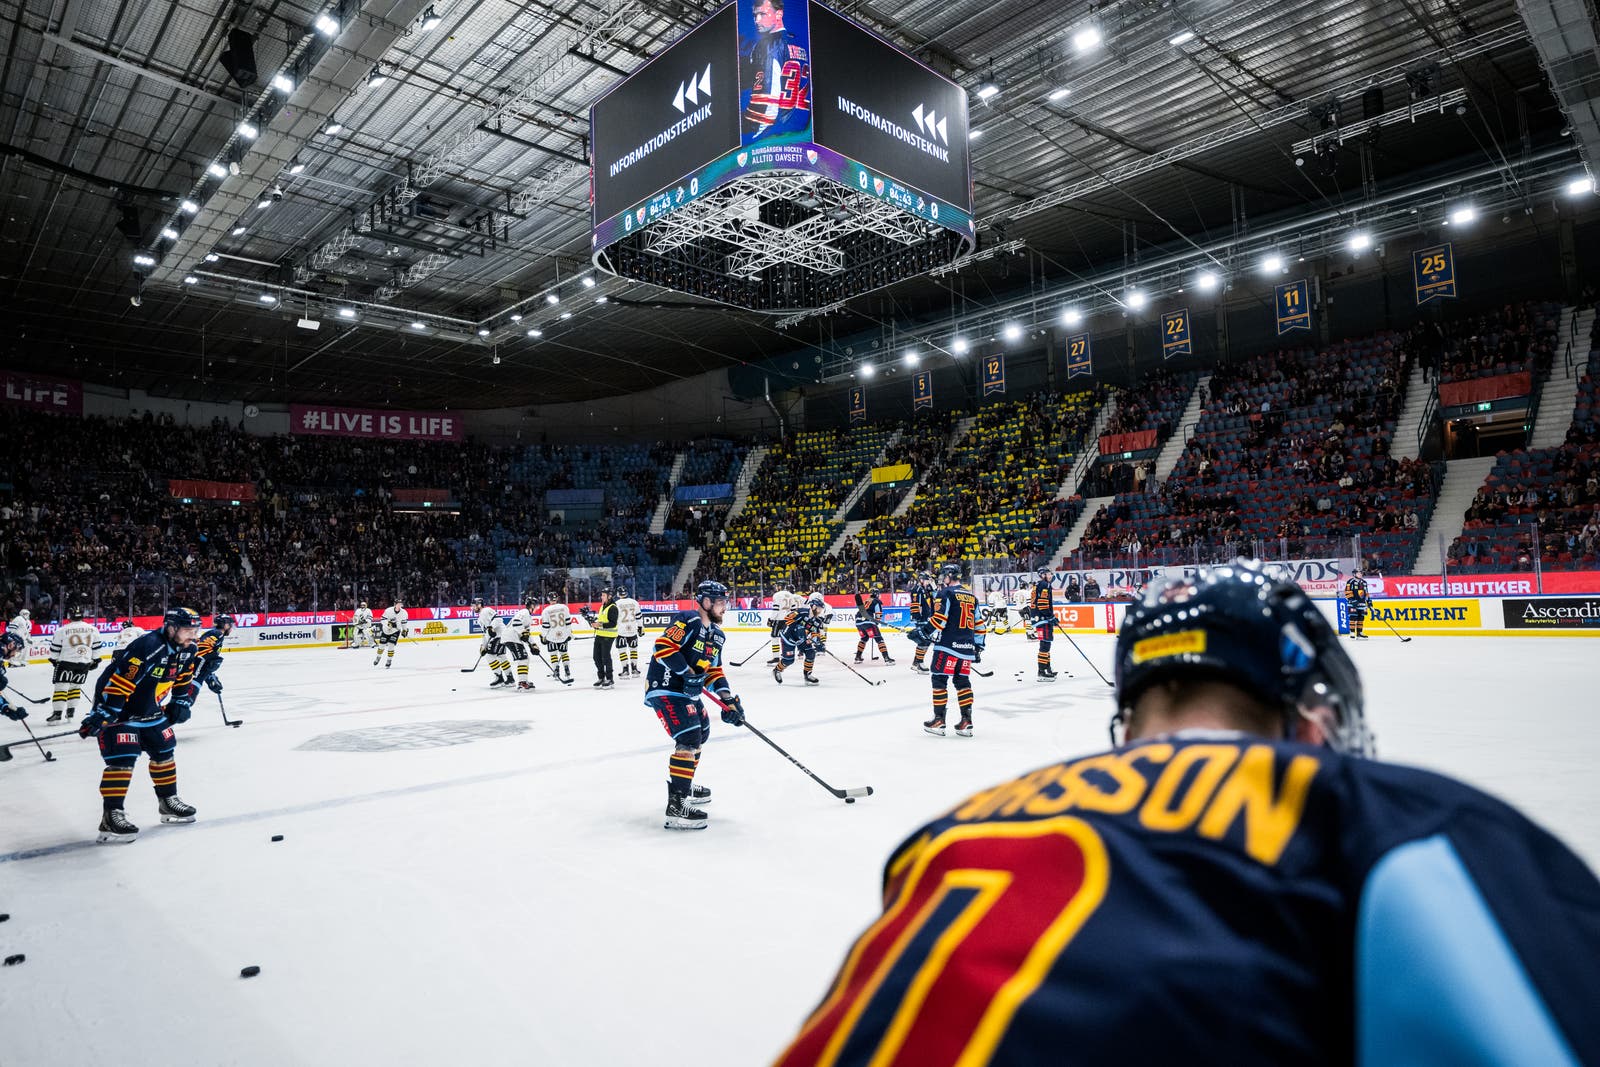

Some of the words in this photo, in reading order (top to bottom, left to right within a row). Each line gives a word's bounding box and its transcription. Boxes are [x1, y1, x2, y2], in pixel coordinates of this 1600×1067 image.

[838, 95, 950, 163] INFORMATIONSTEKNIK
[610, 102, 712, 177] INFORMATIONSTEKNIK
[752, 155, 773, 164] ALLTID
[775, 154, 803, 162] OAVSETT
[690, 177, 699, 196] 0
[860, 170, 868, 189] 0
[931, 202, 938, 219] 0
[625, 214, 632, 231] 0
[1421, 254, 1446, 275] 25
[1284, 289, 1299, 307] 11
[1166, 317, 1184, 335] 22
[1071, 341, 1085, 357] 27
[987, 361, 999, 375] 12
[919, 378, 925, 391] 5
[854, 392, 860, 404] 2
[302, 410, 373, 433] #LIVE
[380, 415, 401, 434] IS
[409, 417, 453, 436] LIFE
[1395, 580, 1531, 595] YRKESBUTIKER
[643, 616, 671, 625] DIVE
[737, 611, 762, 623] RYDS
[959, 601, 975, 630] 15
[1370, 607, 1467, 621] RAMIRENT
[259, 630, 311, 641] Sundström
